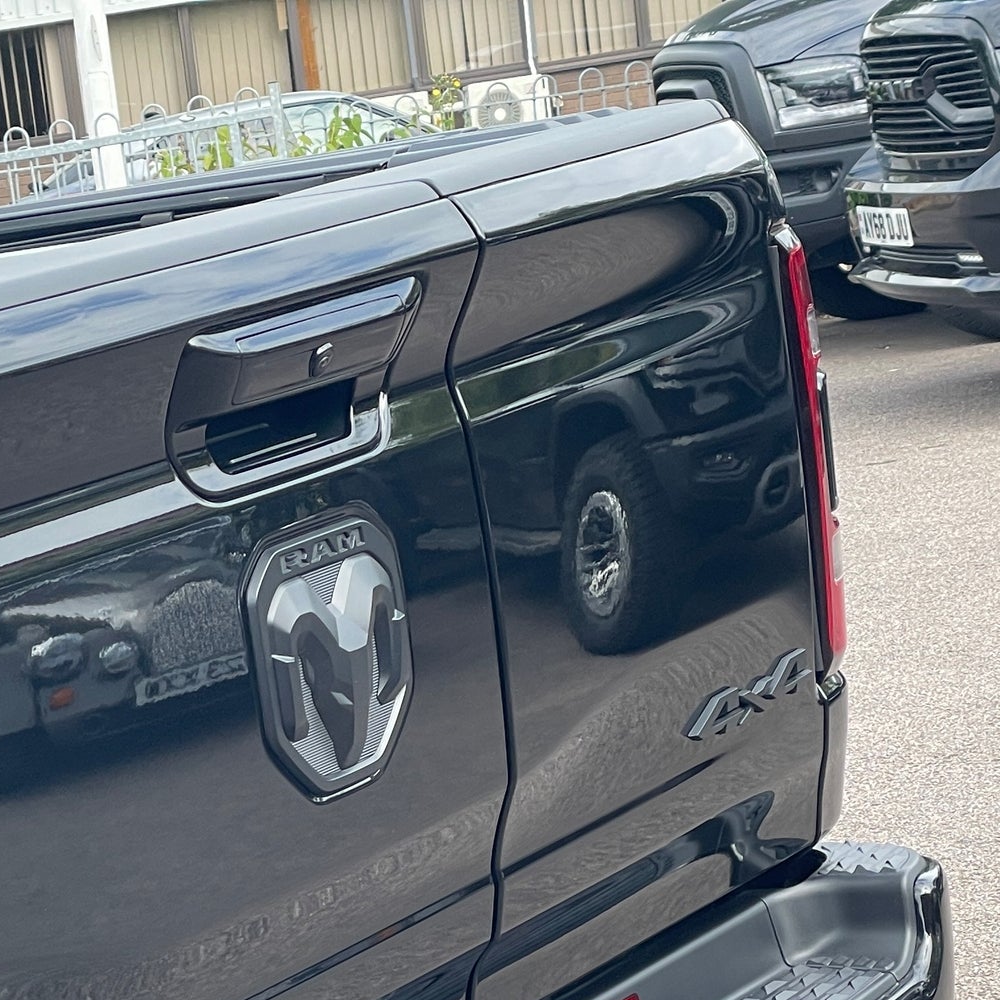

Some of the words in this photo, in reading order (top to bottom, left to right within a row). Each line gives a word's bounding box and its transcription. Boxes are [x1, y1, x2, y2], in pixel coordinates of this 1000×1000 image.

[863, 212, 887, 240] AY68
[886, 213, 909, 241] DJU
[280, 526, 366, 575] RAM
